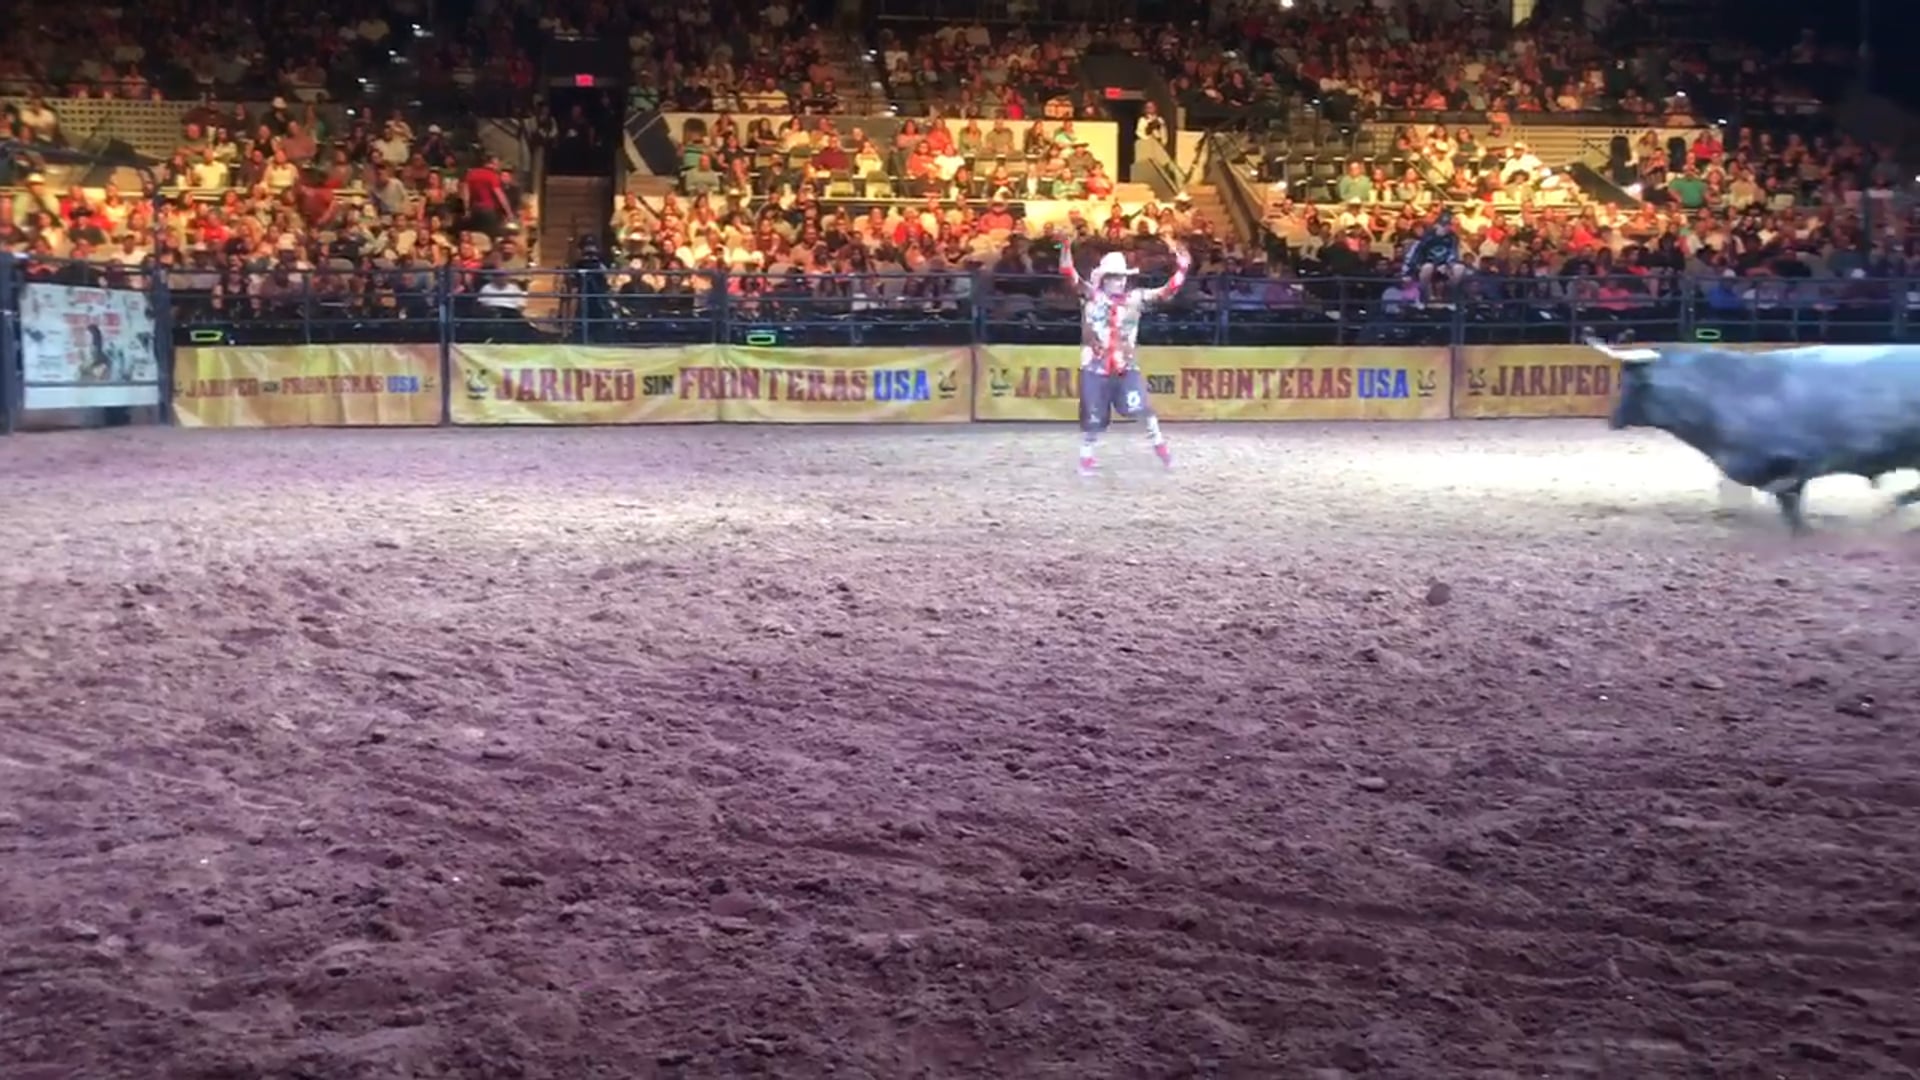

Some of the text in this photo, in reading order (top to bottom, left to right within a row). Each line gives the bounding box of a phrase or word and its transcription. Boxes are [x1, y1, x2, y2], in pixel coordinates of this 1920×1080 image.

[387, 375, 419, 393] USA
[494, 366, 931, 402] JARIPEO SIN FRONTERAS USA
[1147, 374, 1175, 394] SIN
[1180, 367, 1352, 399] FRONTERAS
[1357, 368, 1409, 399] USA
[1491, 364, 1611, 396] JARIPEO
